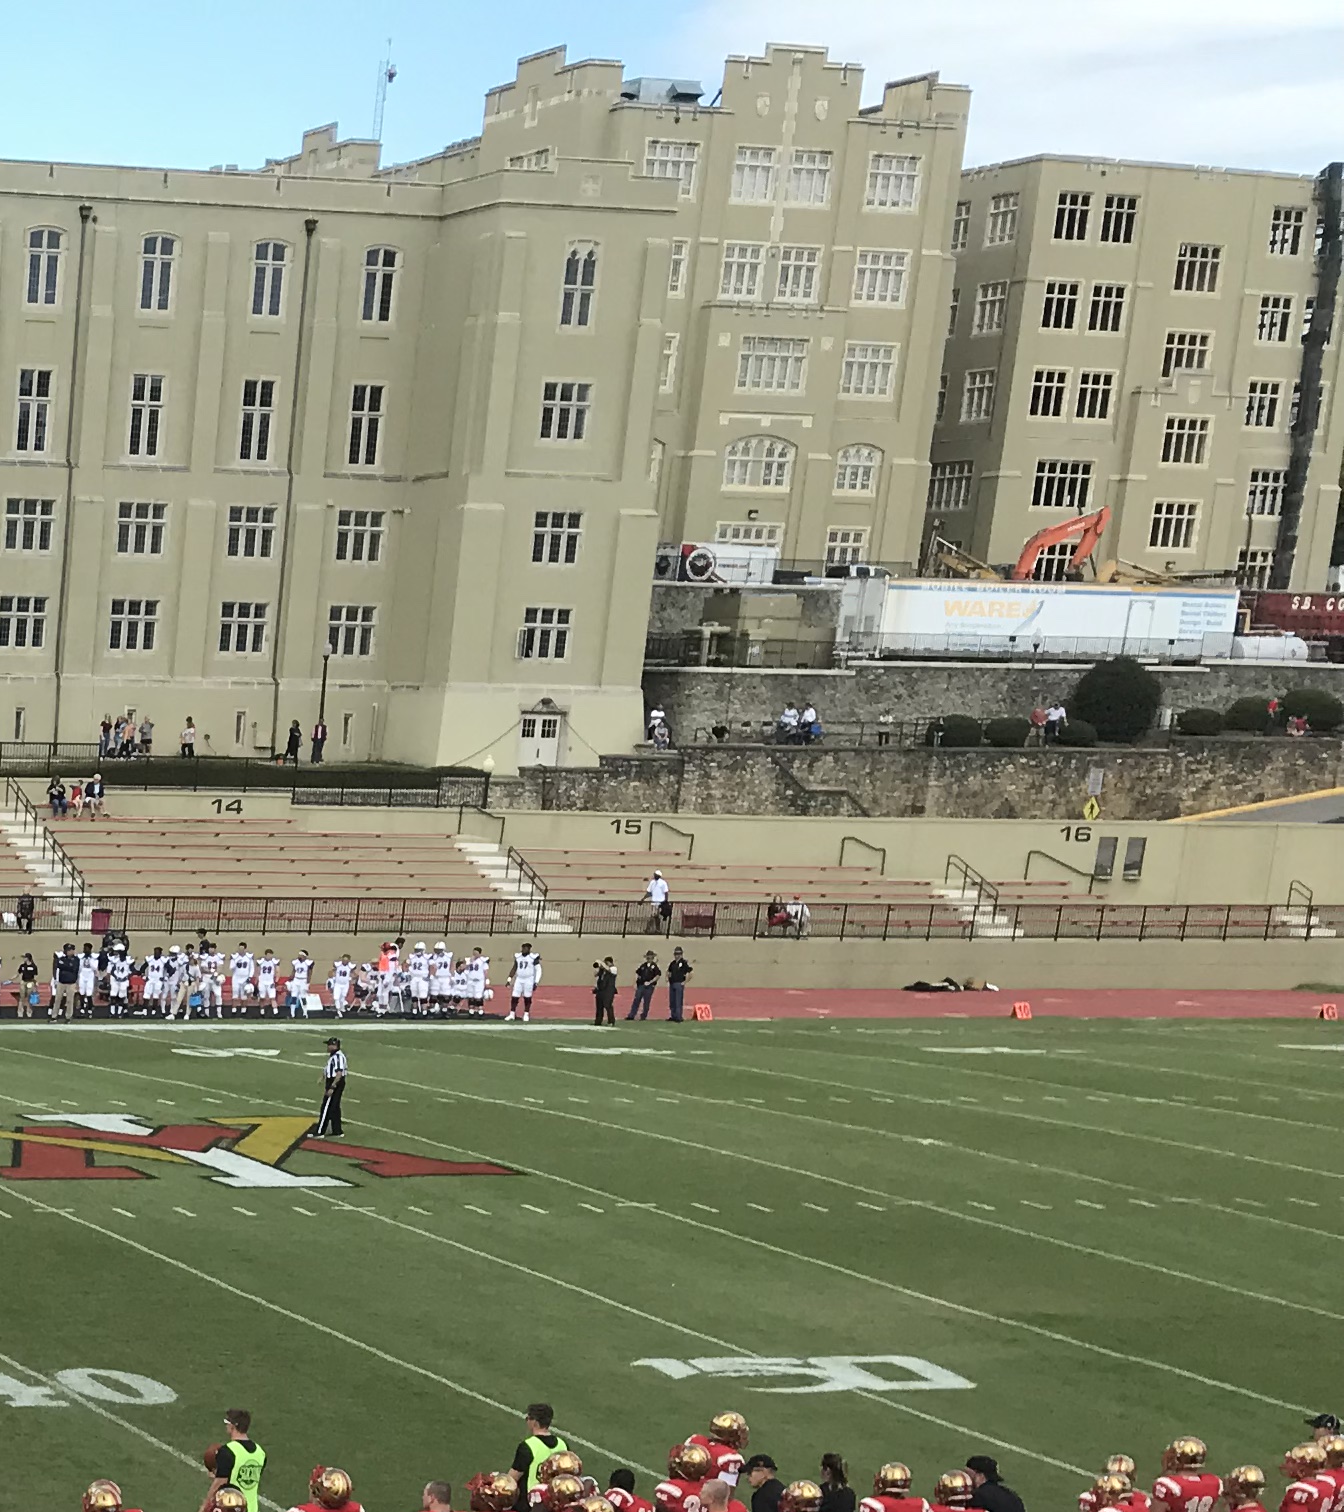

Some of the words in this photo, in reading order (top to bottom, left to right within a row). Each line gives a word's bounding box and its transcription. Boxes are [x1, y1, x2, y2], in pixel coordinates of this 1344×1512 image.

[944, 599, 1019, 619] WARE
[211, 798, 243, 815] 14
[610, 818, 642, 835] 15
[1060, 826, 1092, 843] 16
[697, 1006, 711, 1020] 20
[1325, 1005, 1336, 1019] G
